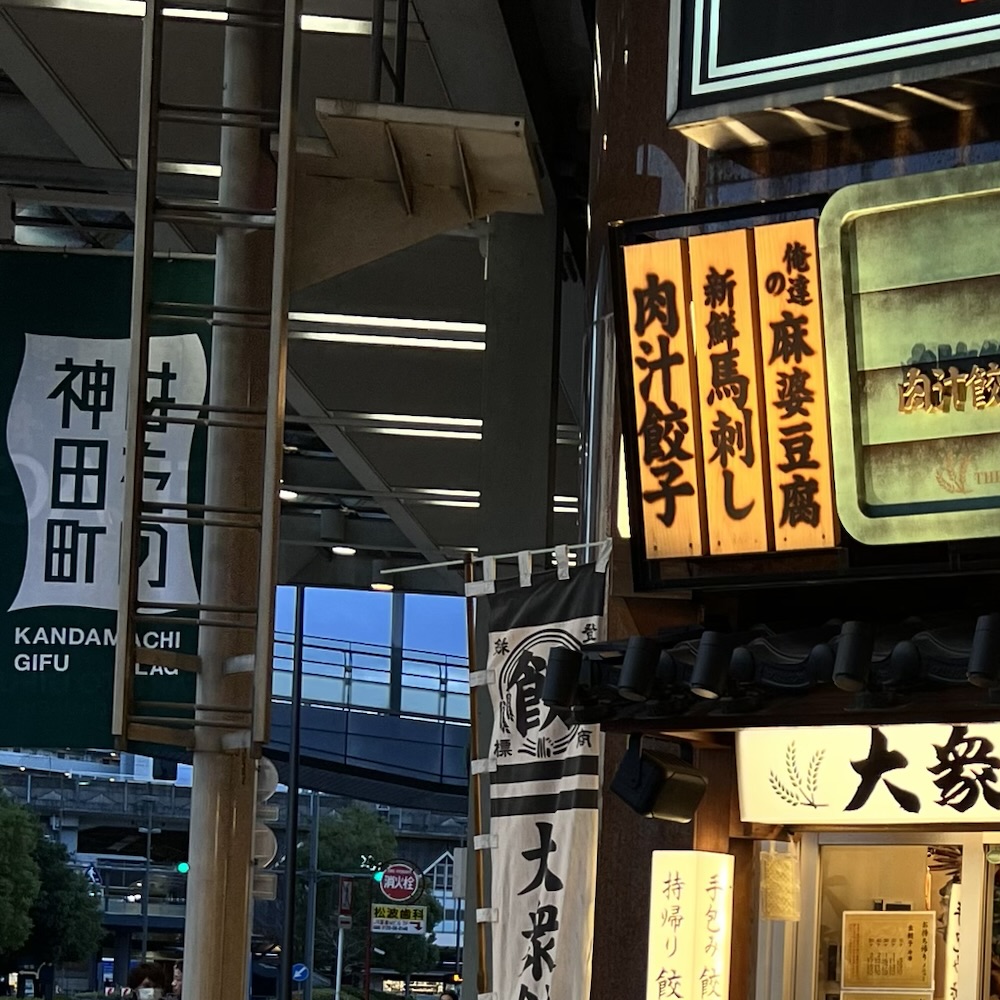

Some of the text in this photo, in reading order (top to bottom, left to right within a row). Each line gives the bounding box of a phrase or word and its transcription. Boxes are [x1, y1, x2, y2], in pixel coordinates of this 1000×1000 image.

[633, 272, 695, 528] 肉汁餃子
[703, 266, 755, 521] 新鮮馬刺し
[47, 357, 115, 584] 神田町
[14, 653, 70, 672] GIFU
[374, 907, 424, 920] 松波歯科
[384, 875, 415, 890] 消火栓
